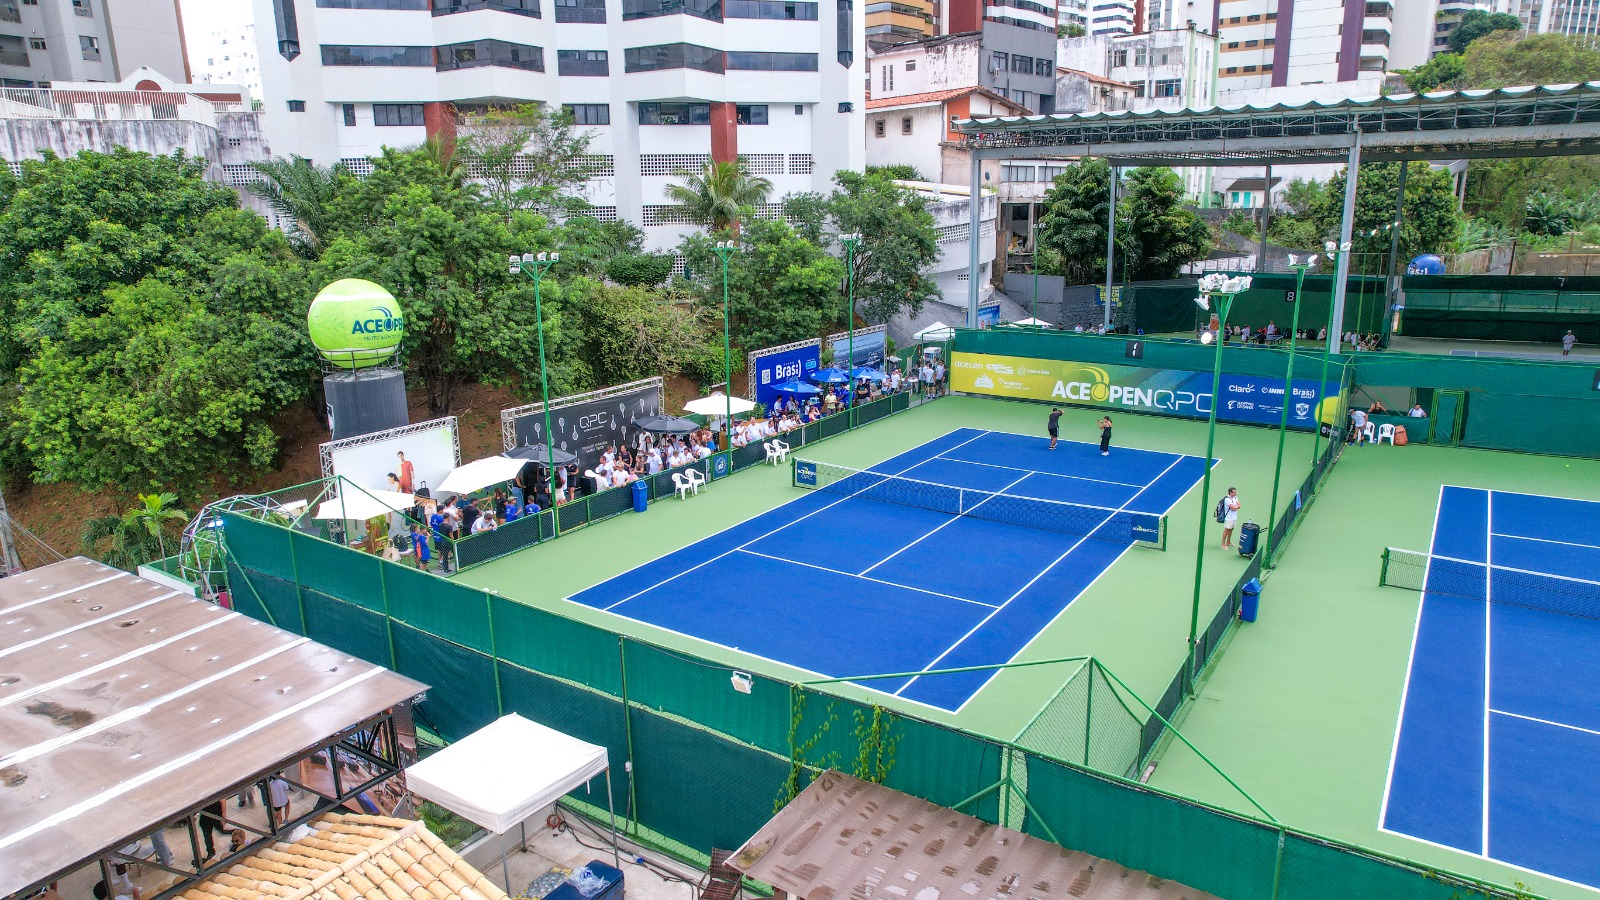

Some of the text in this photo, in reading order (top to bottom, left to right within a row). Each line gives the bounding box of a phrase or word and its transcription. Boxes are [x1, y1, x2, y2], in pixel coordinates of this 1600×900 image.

[1287, 291, 1295, 302] 8
[1132, 343, 1137, 357] 1
[1228, 384, 1252, 394] Claro
[1154, 389, 1213, 413] QPC
[580, 412, 607, 428] QPC
